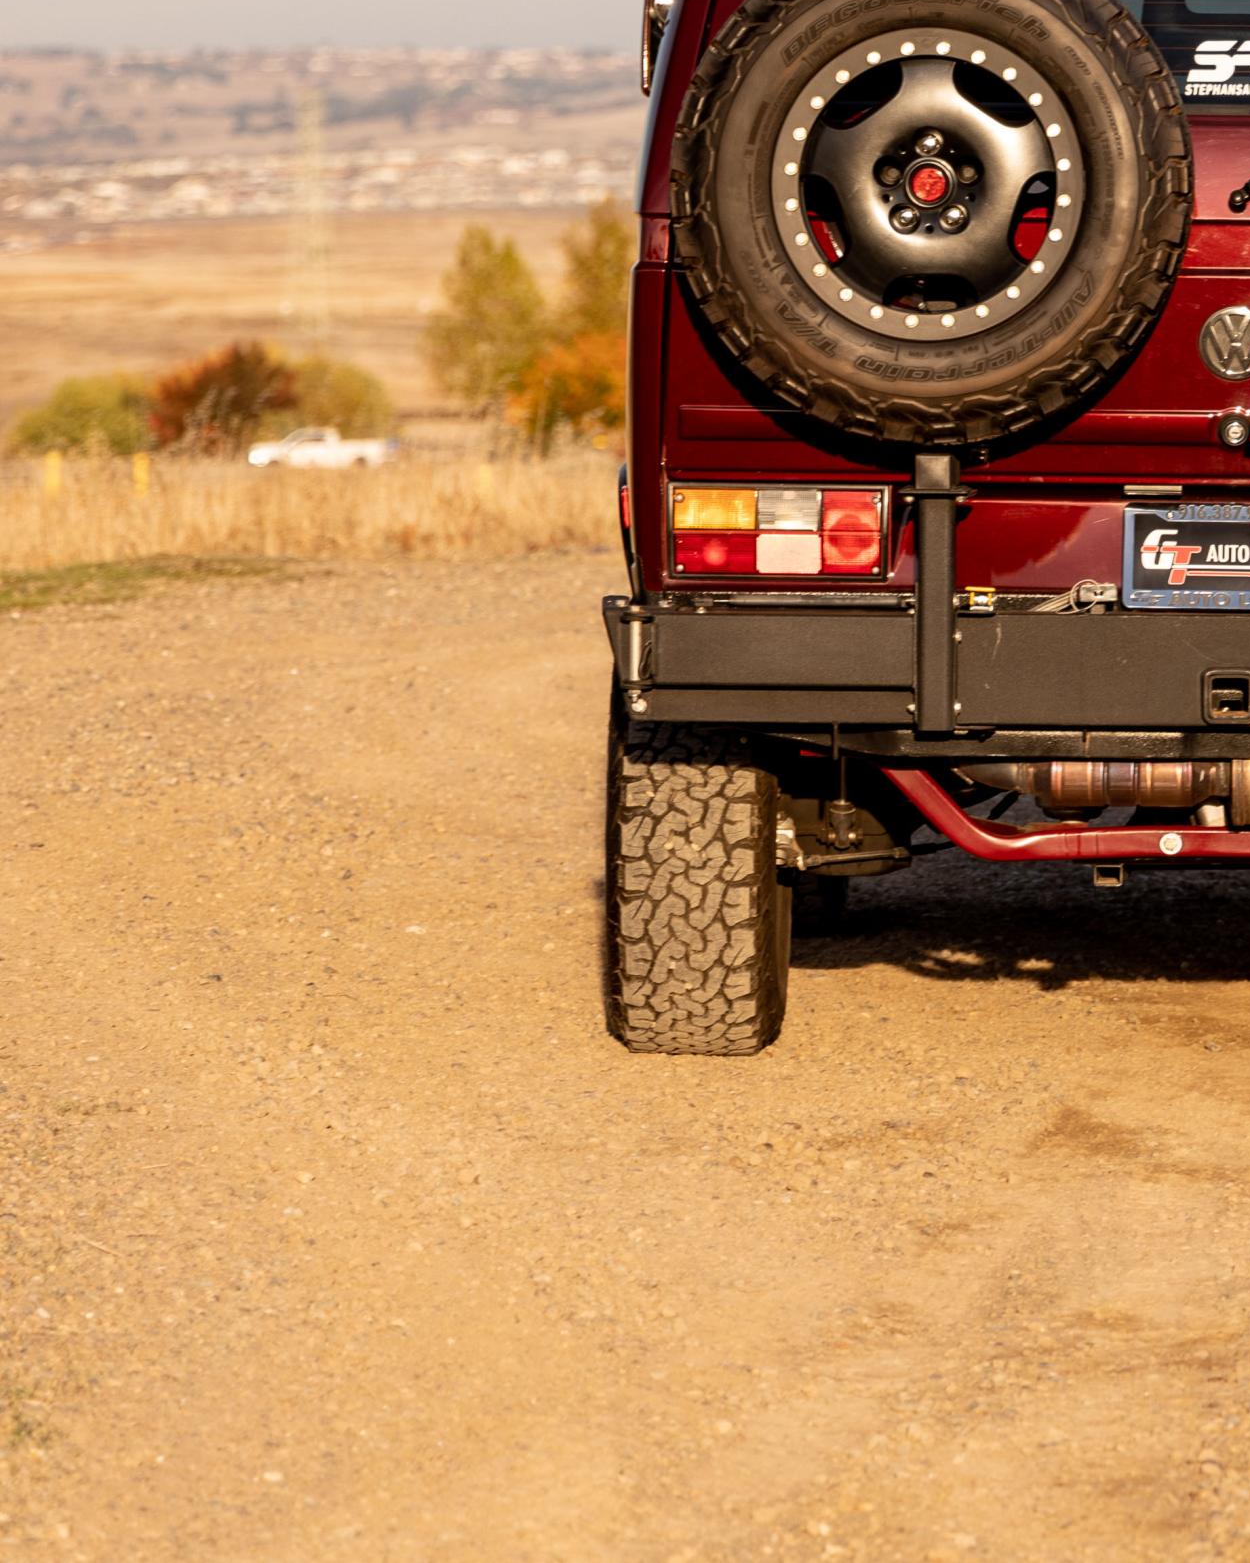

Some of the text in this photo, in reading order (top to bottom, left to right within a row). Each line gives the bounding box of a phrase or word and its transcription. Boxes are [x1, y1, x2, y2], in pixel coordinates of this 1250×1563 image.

[1140, 529, 1202, 585] GT
[1206, 544, 1250, 563] AUTO
[1168, 590, 1231, 606] AUTO
